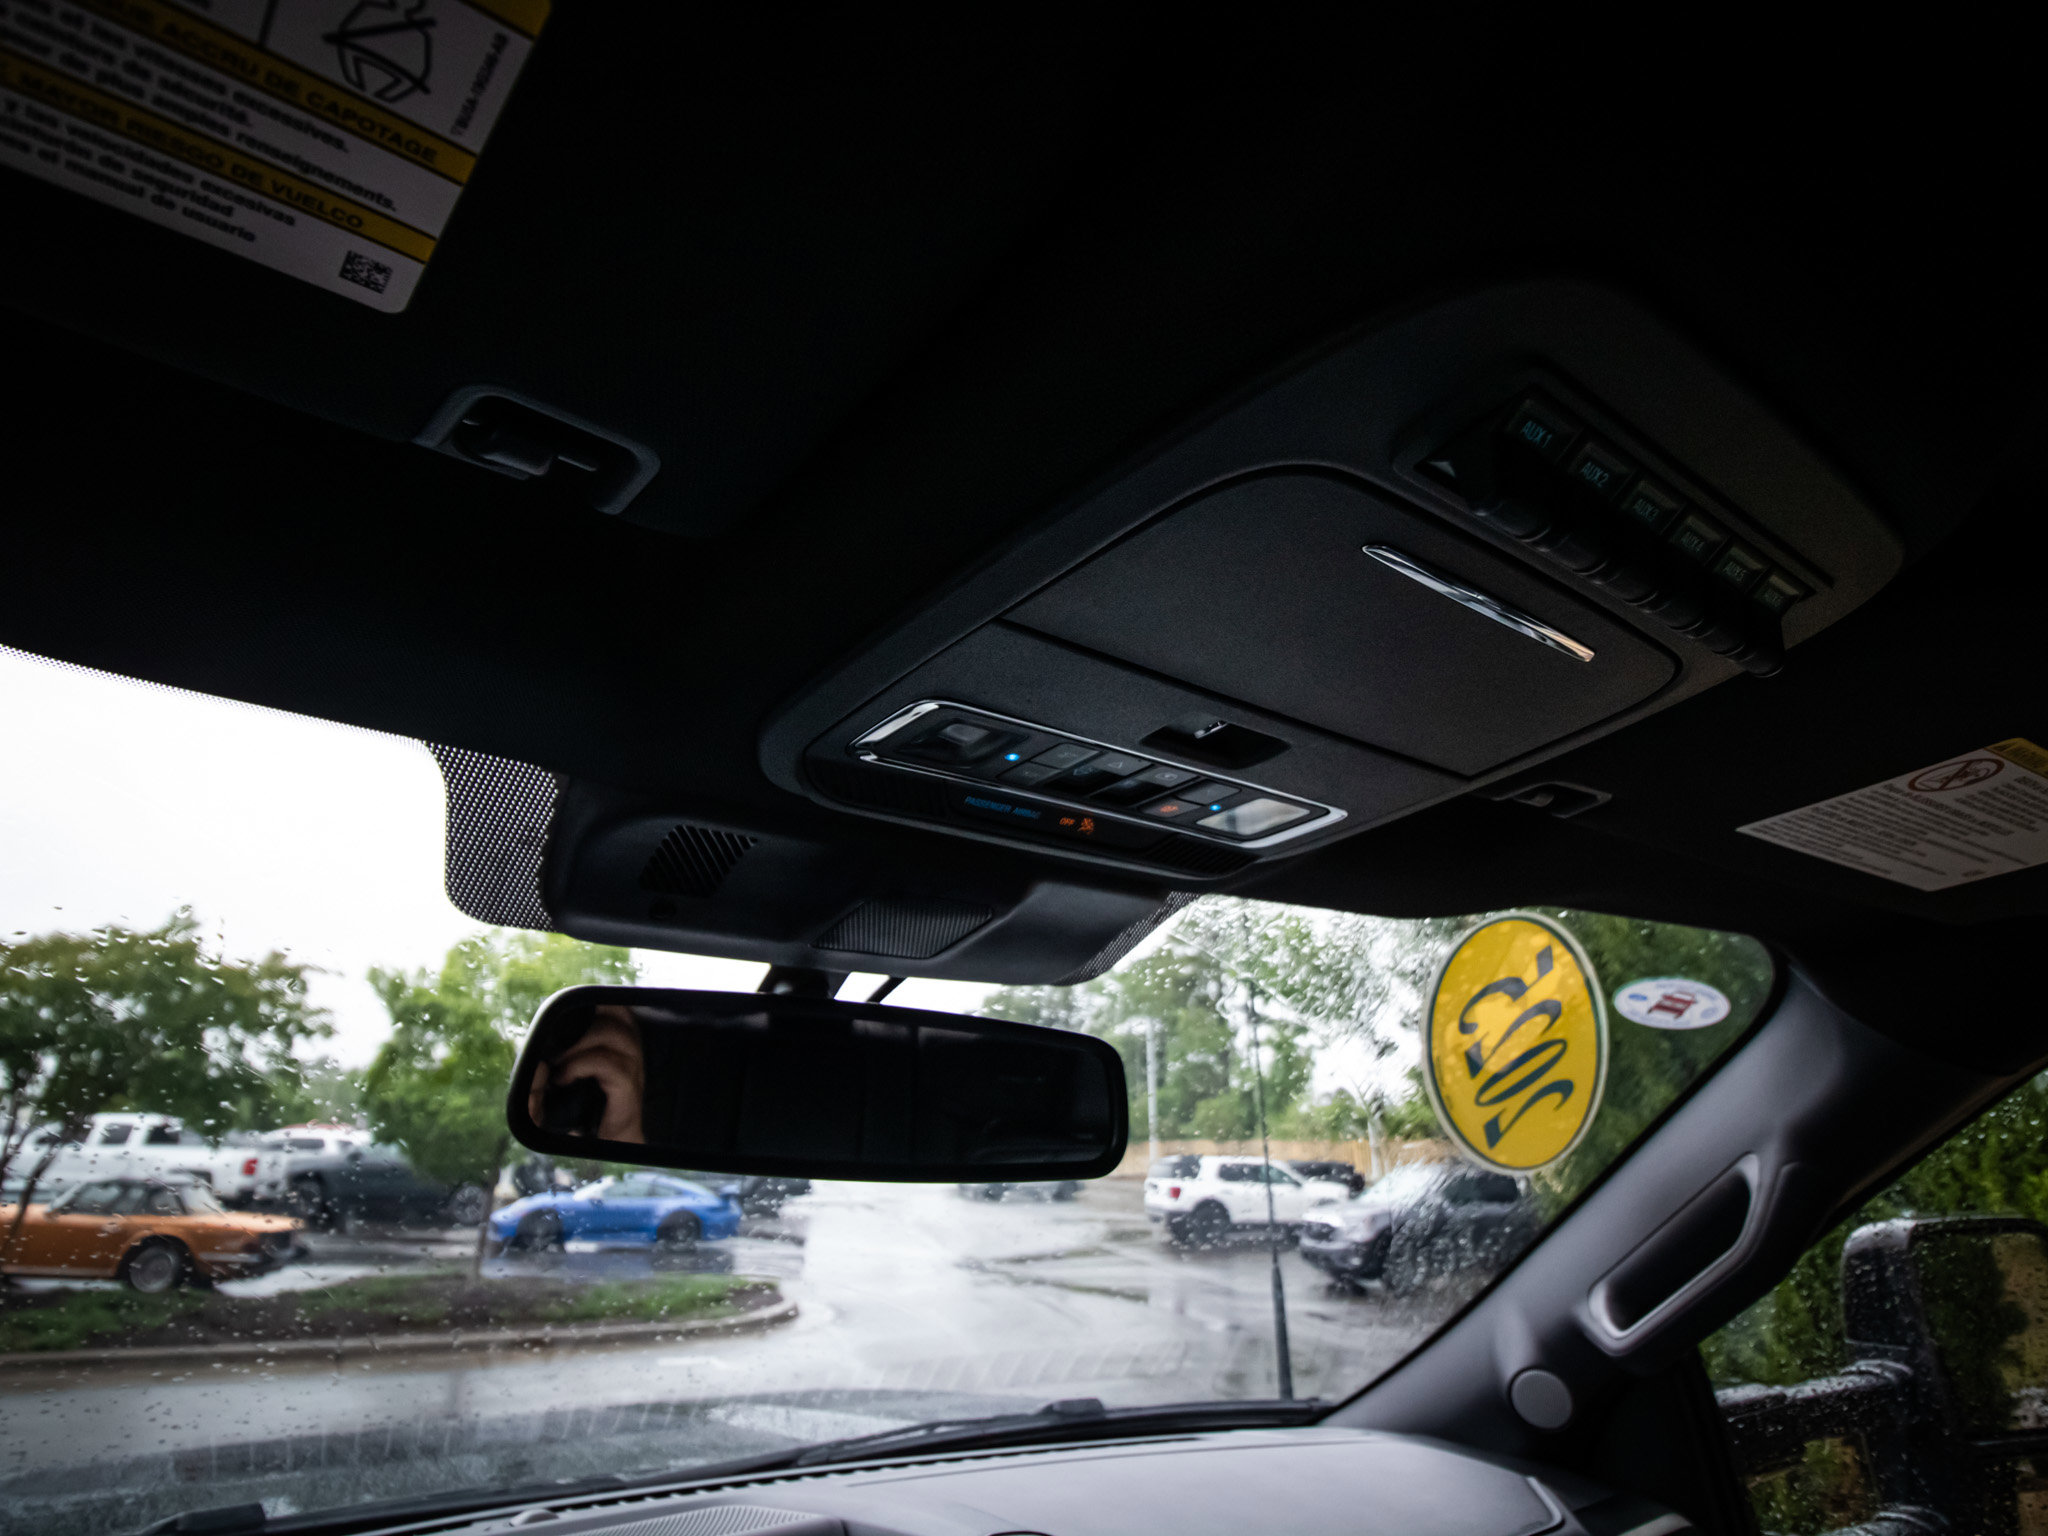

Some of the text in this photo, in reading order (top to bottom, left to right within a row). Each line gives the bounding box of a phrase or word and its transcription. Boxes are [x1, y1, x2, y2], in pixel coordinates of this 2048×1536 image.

[306, 92, 437, 163] CAPOTAGE
[126, 118, 225, 168] RIESGO
[231, 162, 263, 187] DE
[271, 178, 364, 228] VUELCO
[200, 179, 295, 226] excesivas
[236, 131, 397, 213] renseignements.
[182, 206, 257, 243] usuario
